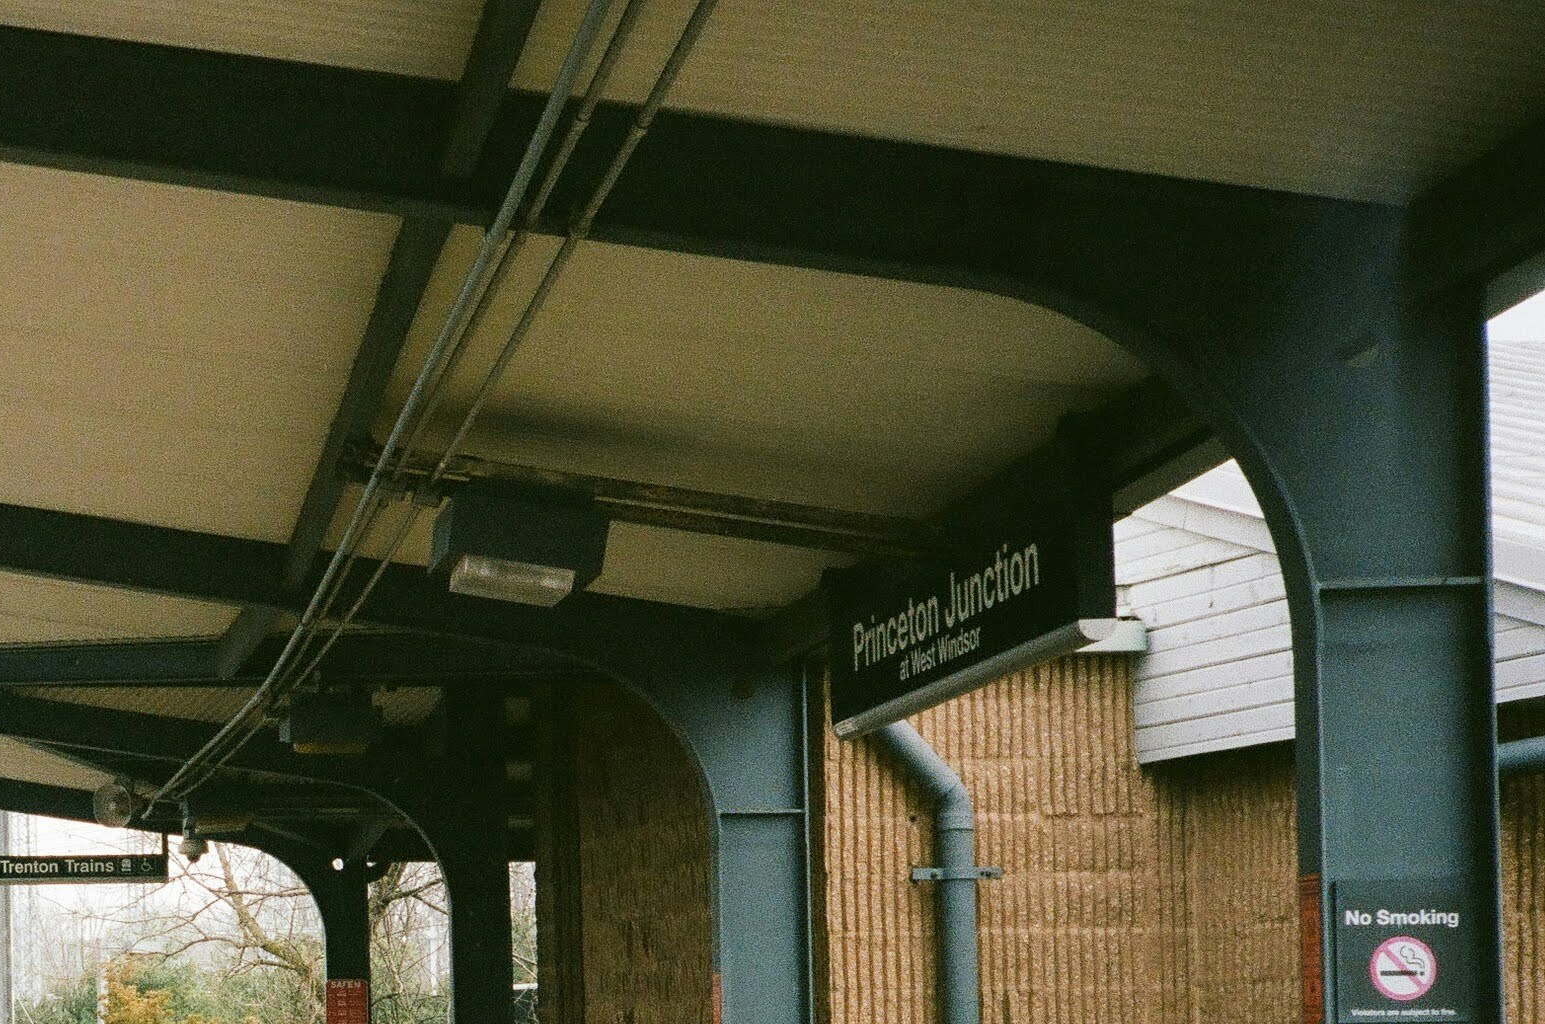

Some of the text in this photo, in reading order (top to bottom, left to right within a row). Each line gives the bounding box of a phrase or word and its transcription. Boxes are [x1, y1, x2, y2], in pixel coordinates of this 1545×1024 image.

[853, 543, 1040, 672] Princeton Junction
[899, 626, 981, 681] at West Windsor
[0, 860, 58, 874] Trenton
[65, 858, 115, 873] Trains
[1344, 908, 1460, 928] No Smoking
